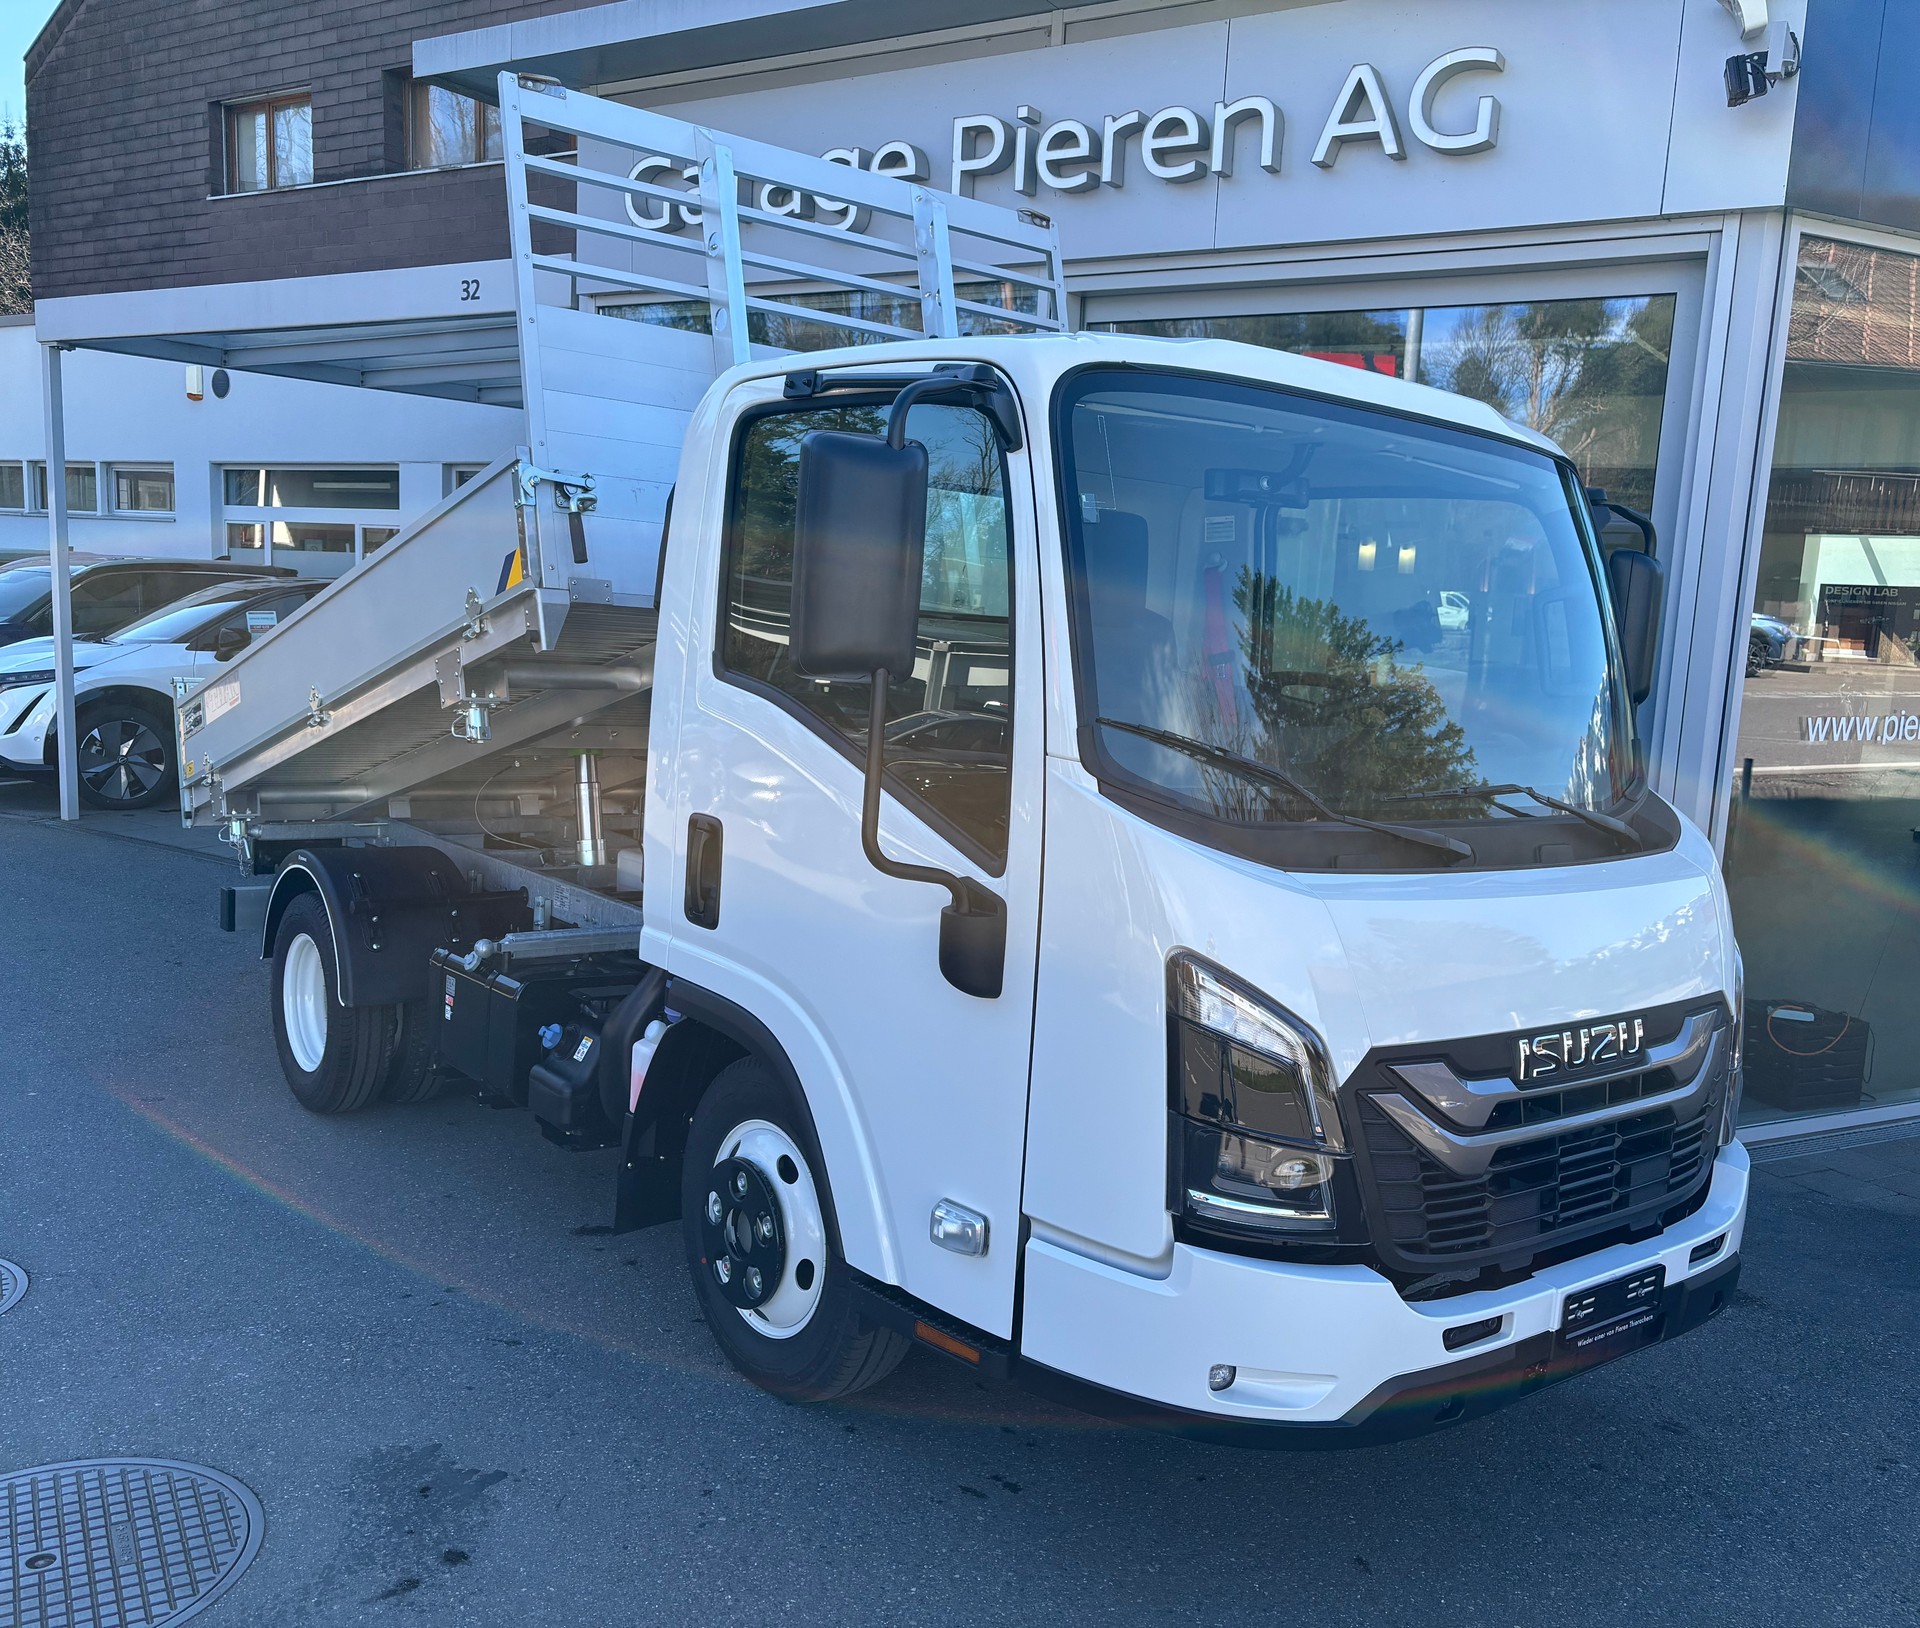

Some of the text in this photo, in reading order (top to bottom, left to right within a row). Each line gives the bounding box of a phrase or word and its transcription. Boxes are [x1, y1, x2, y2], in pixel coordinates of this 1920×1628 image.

[952, 95, 1284, 196] Pieren
[1311, 47, 1505, 168] AG
[460, 279, 480, 301] 32
[1825, 586, 1899, 597] DESIGN LAB
[1807, 710, 1920, 745] www.pie
[1519, 1018, 1643, 1080] ISUZU
[1577, 1336, 1594, 1347] Wieder
[1594, 1333, 1606, 1342] einer
[1615, 1324, 1629, 1334] Pieren
